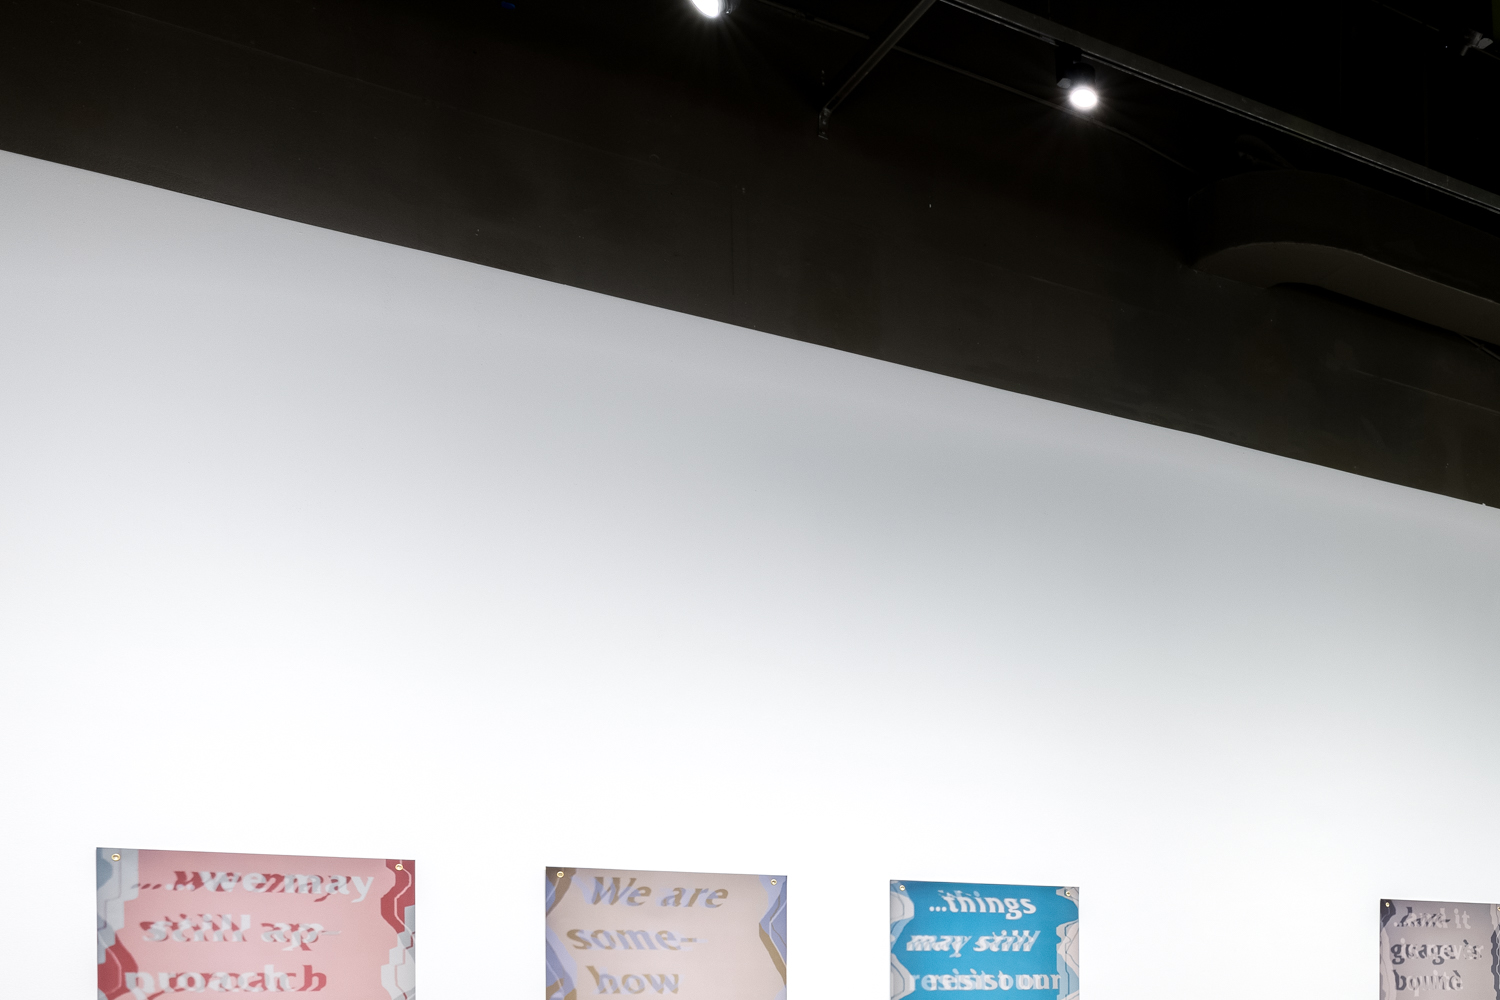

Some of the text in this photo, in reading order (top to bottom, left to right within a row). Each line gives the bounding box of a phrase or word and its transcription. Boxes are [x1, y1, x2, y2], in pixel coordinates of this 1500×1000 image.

[253, 871, 374, 903] may
[571, 876, 729, 909] We are
[929, 890, 1037, 920] ...things
[139, 914, 251, 943] still
[567, 928, 708, 951] some-
[906, 929, 1041, 958] may still
[125, 964, 327, 1000] proach
[585, 965, 685, 995] how
[913, 968, 1009, 991] resist
